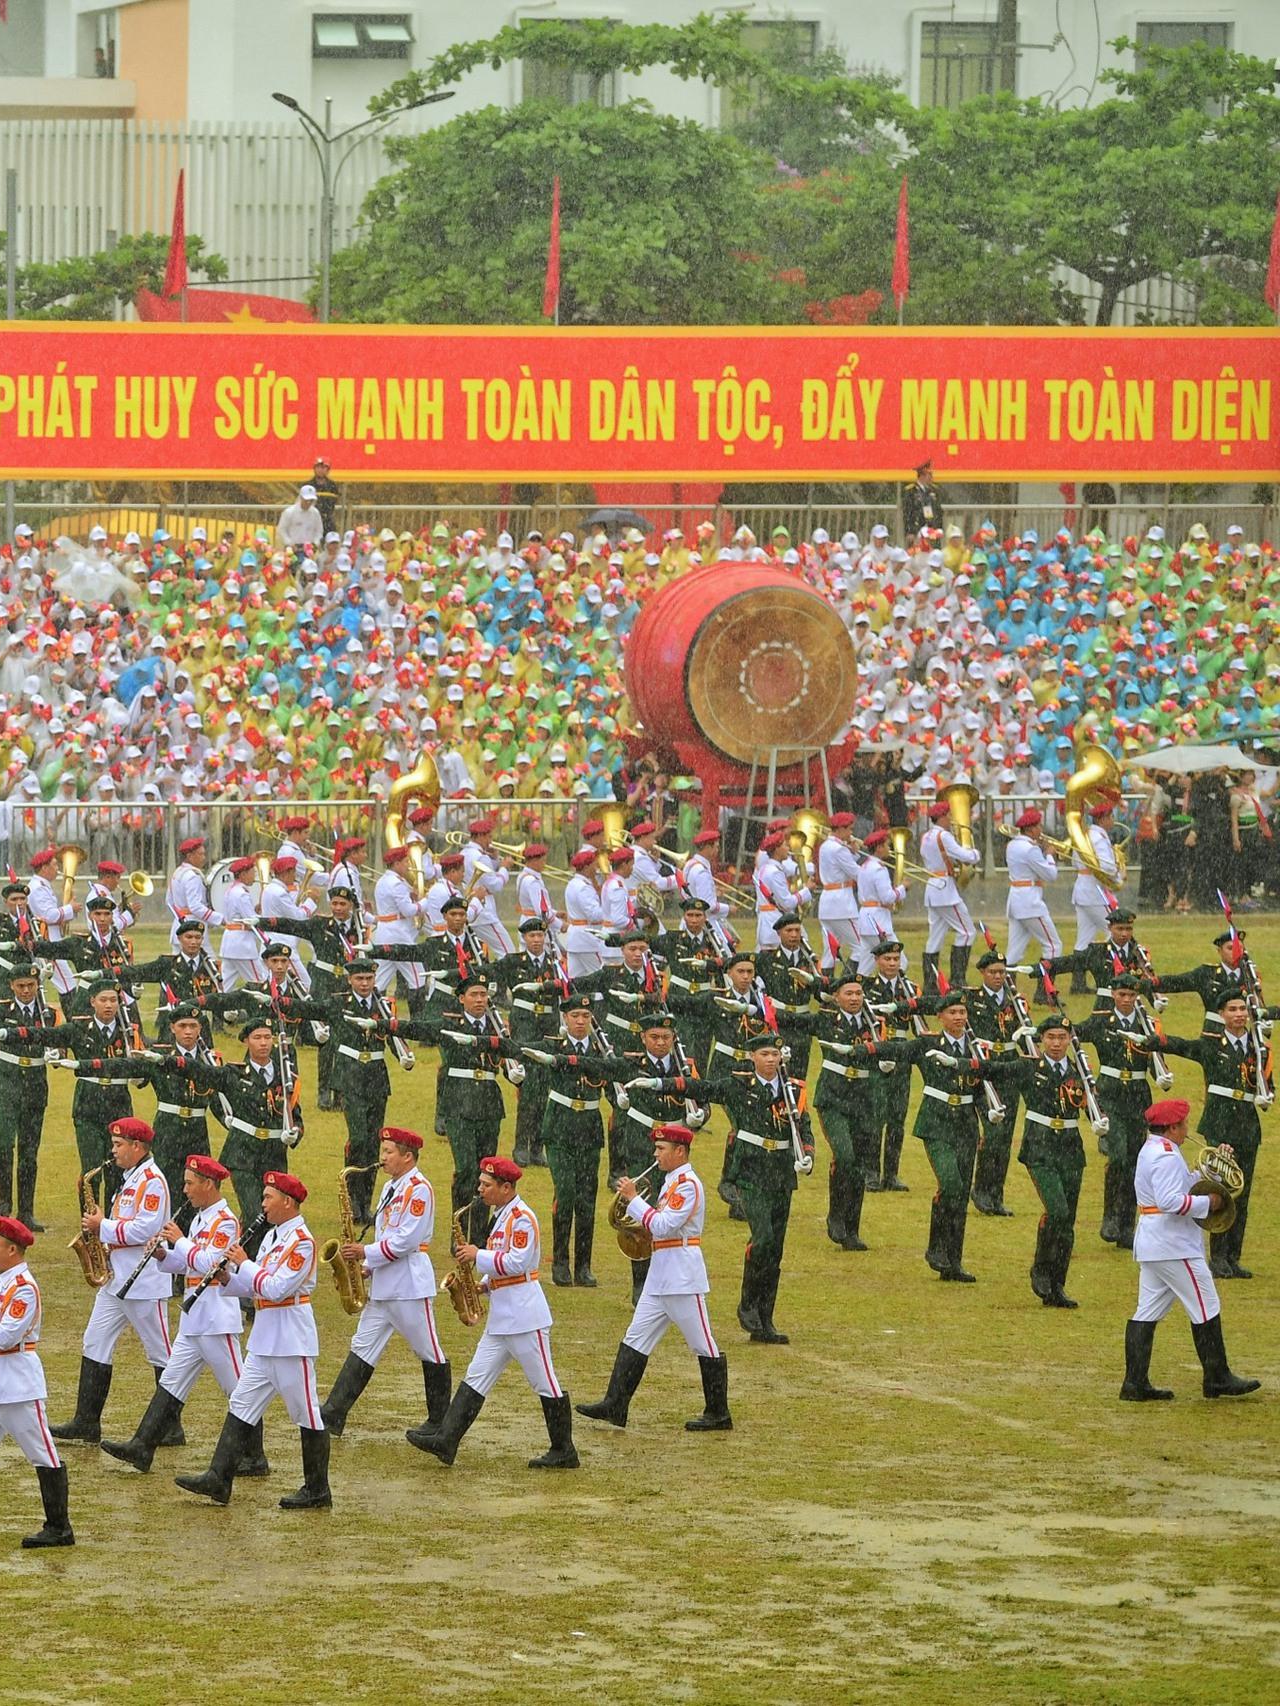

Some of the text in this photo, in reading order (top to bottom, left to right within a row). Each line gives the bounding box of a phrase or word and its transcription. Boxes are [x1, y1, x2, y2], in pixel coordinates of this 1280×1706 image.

[114, 376, 197, 440] HUY
[214, 363, 299, 440] SỨC
[317, 377, 444, 455] MẠNH
[460, 365, 571, 442] TOÀN
[589, 365, 676, 441] DÂN
[692, 365, 783, 455] TỘC,
[800, 354, 884, 441] ĐẨY
[901, 379, 1027, 455] MẠNH
[1044, 366, 1154, 442] TOÀN
[1172, 366, 1270, 455] DIỆN
